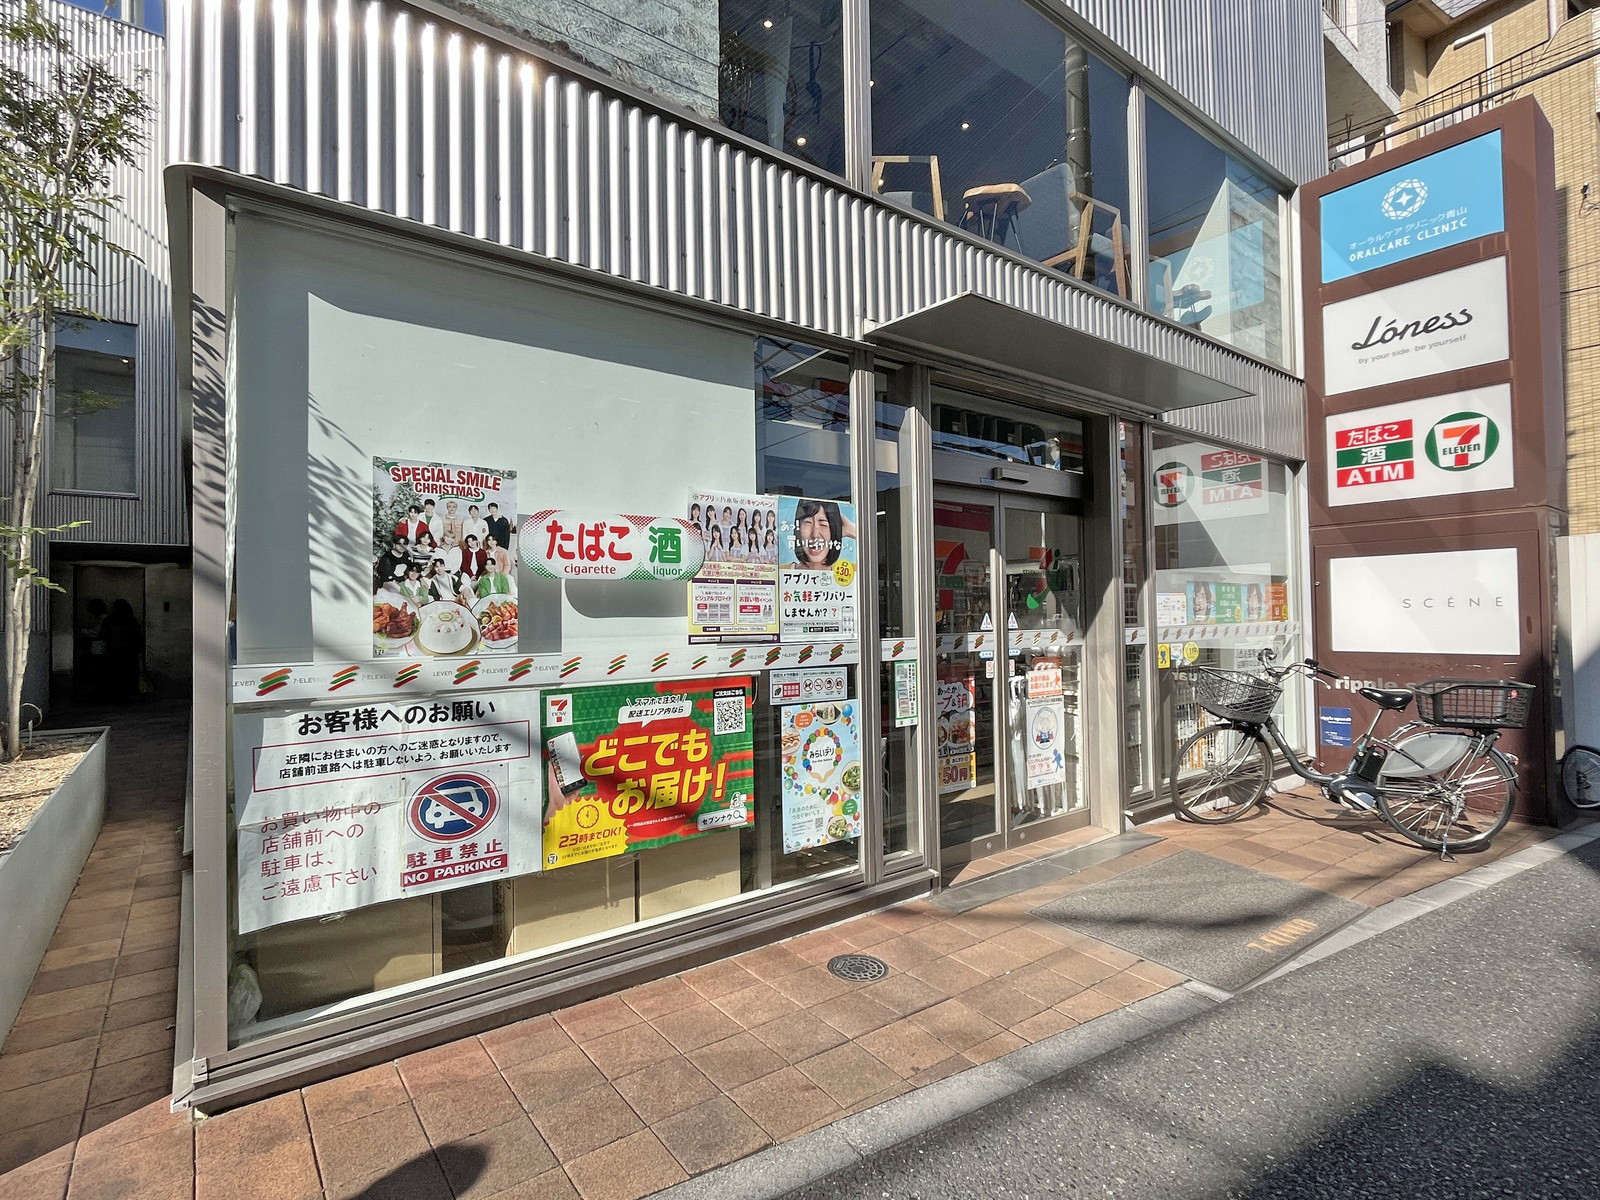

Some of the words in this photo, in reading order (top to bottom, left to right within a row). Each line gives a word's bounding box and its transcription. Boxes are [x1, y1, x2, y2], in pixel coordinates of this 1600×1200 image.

[1348, 237, 1411, 262] ORALCARE
[1416, 217, 1468, 241] CLINIC
[1371, 352, 1391, 362] your
[1414, 342, 1426, 352] be
[1428, 334, 1468, 352] yourself
[1347, 424, 1400, 446] たばこ
[1361, 446, 1387, 464] 酒
[390, 467, 454, 484] SPECIAL
[456, 470, 501, 492] SMILE
[1346, 464, 1405, 485] ATM
[414, 482, 481, 498] CHRISTMAS
[780, 519, 801, 532] あっ!
[546, 519, 633, 562] たばこ
[648, 526, 682, 564] 酒
[563, 563, 617, 576] cigarette
[652, 565, 683, 577] liquor
[783, 572, 820, 585] アプリで
[783, 590, 853, 603] お気軽デリバリー
[1401, 595, 1504, 609] SCÈNE
[784, 607, 828, 619] しませんか?
[297, 700, 496, 736] お客様へのお願い
[628, 706, 684, 718] 配送エリア内なら
[279, 743, 513, 780] 店舗前道路へは駐車しないよう、お願いいたします
[285, 733, 505, 766] 近隣にお住まいの方へのご迷惑となりますので、
[584, 728, 709, 777] どこでも
[809, 746, 835, 759] みらいデリ
[611, 762, 727, 817] お届け!
[260, 802, 382, 834] お買い物中の
[702, 813, 733, 825] セブンナウ
[261, 823, 365, 855] 店舗前への
[558, 827, 622, 849] 23時までOK!
[260, 851, 336, 879] 駐車は、
[406, 839, 504, 870] 駐車禁止
[403, 871, 430, 886] NO
[434, 857, 503, 878] PARKING
[261, 867, 379, 902] ご遠慮下さい
